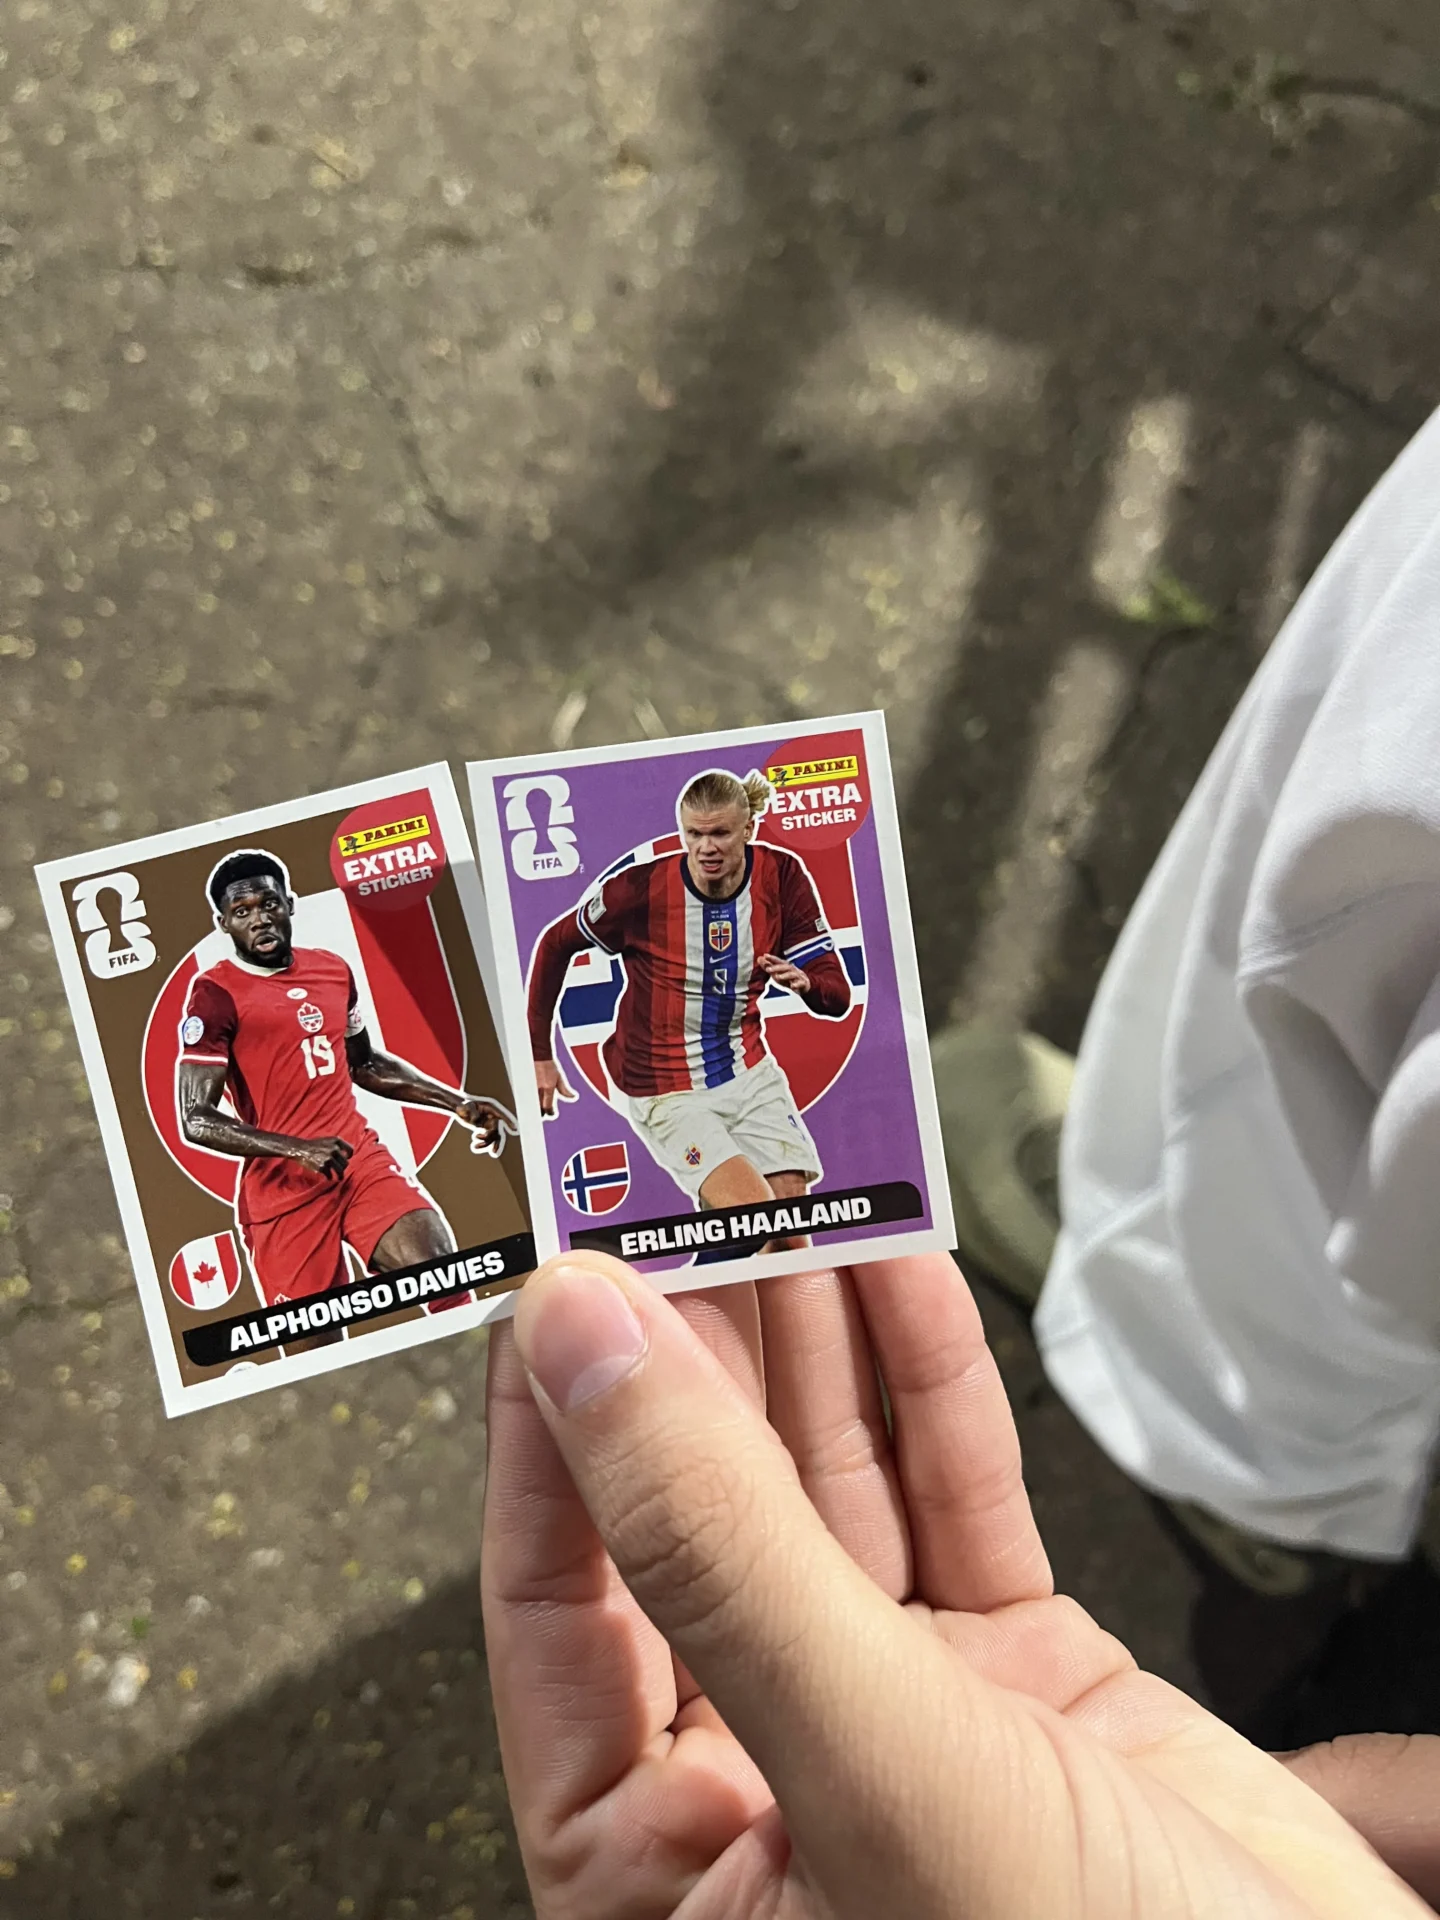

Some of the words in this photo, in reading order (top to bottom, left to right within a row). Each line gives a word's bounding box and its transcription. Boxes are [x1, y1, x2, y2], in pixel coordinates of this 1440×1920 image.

[793, 759, 854, 776] PANINI
[771, 783, 862, 814] EXTRA
[363, 819, 425, 842] PANINI
[781, 808, 856, 830] STICKER
[343, 841, 438, 882] EXTRA
[533, 857, 563, 871] FIFA
[358, 865, 433, 896] STICKER
[108, 953, 140, 969] FIFA
[620, 1219, 725, 1256] ERLING
[729, 1196, 872, 1240] HAALAND
[230, 1284, 394, 1352] ALPHONSO
[397, 1251, 505, 1303] DAVIES
